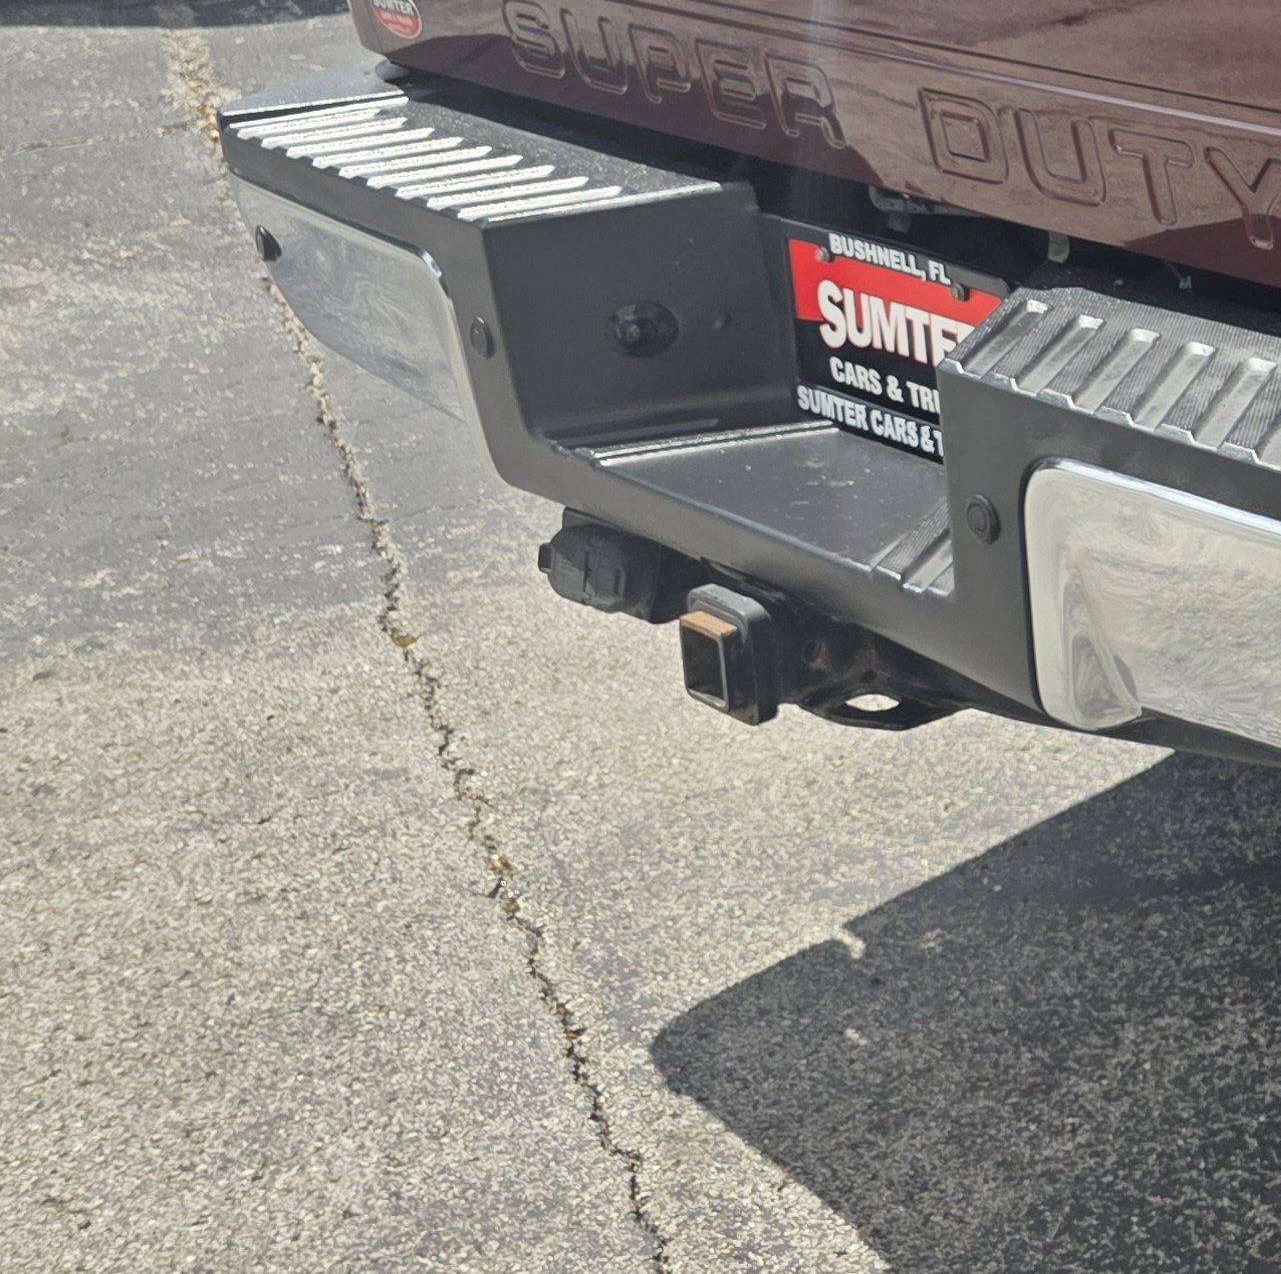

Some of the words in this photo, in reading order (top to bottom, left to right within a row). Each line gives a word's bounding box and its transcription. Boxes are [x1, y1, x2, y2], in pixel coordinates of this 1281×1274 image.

[828, 232, 927, 282] BUSHNELL,
[927, 259, 952, 285] FL
[816, 279, 976, 368] SUMTE
[829, 356, 883, 395] CARS
[886, 374, 905, 403] &
[797, 384, 869, 431] SUMTER
[869, 409, 919, 448] CARS
[919, 425, 935, 454] &
